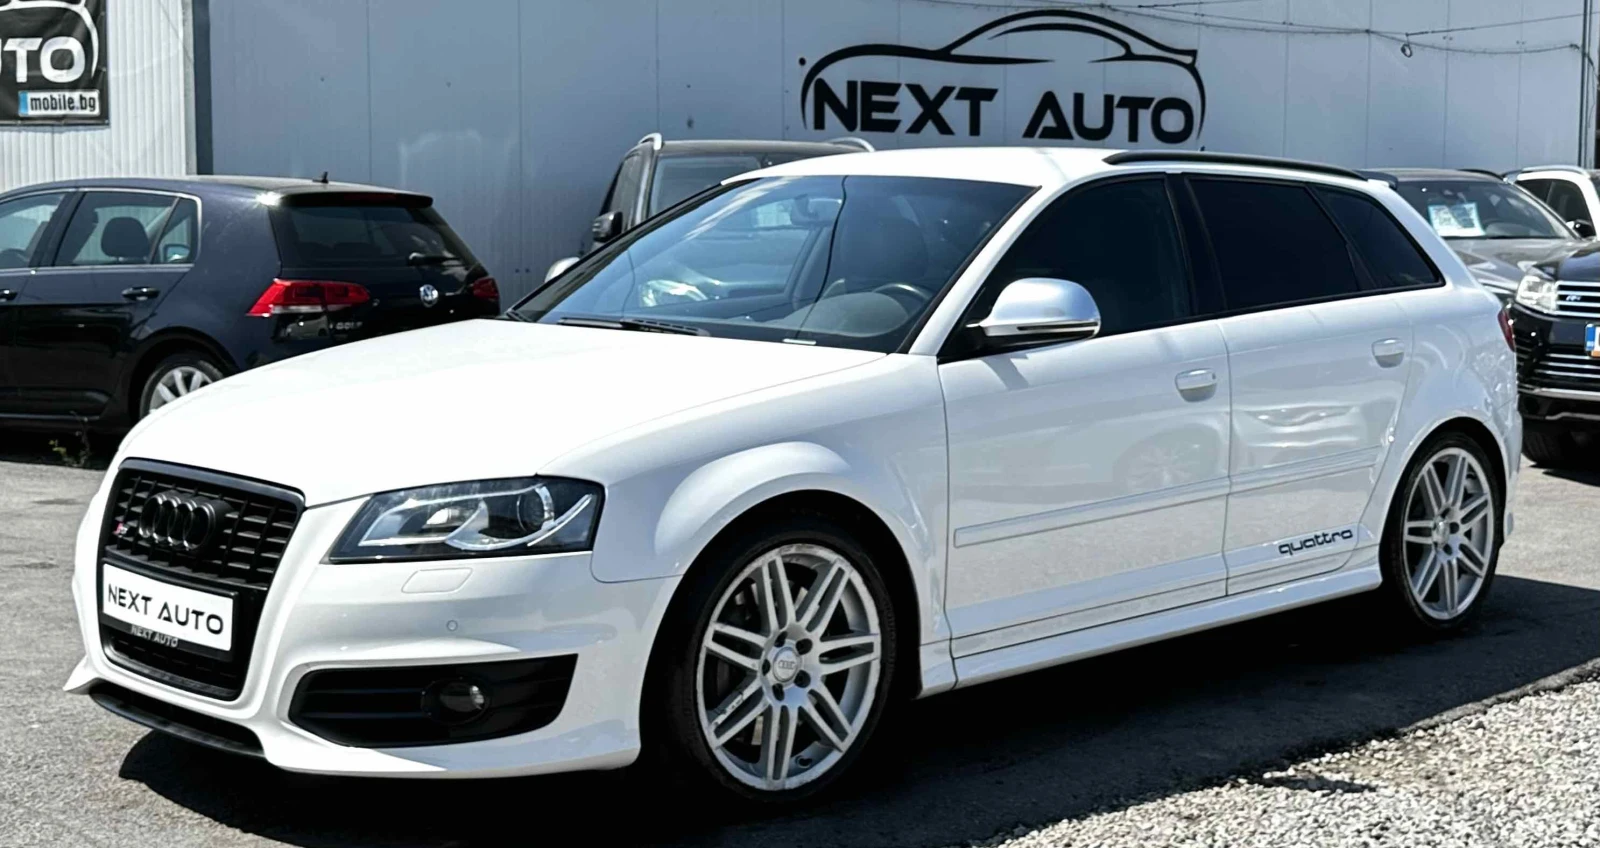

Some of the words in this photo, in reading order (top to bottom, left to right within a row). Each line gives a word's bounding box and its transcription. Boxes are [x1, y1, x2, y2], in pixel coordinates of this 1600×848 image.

[0, 36, 85, 83] TO
[30, 94, 96, 112] mobile.bg
[813, 78, 998, 136] NEXT
[1022, 91, 1195, 144] AUTO
[1278, 529, 1353, 555] quattro
[108, 583, 153, 615] NEXT
[157, 601, 224, 635] AUTO
[131, 624, 153, 640] NEXT
[153, 633, 179, 648] AUTO
